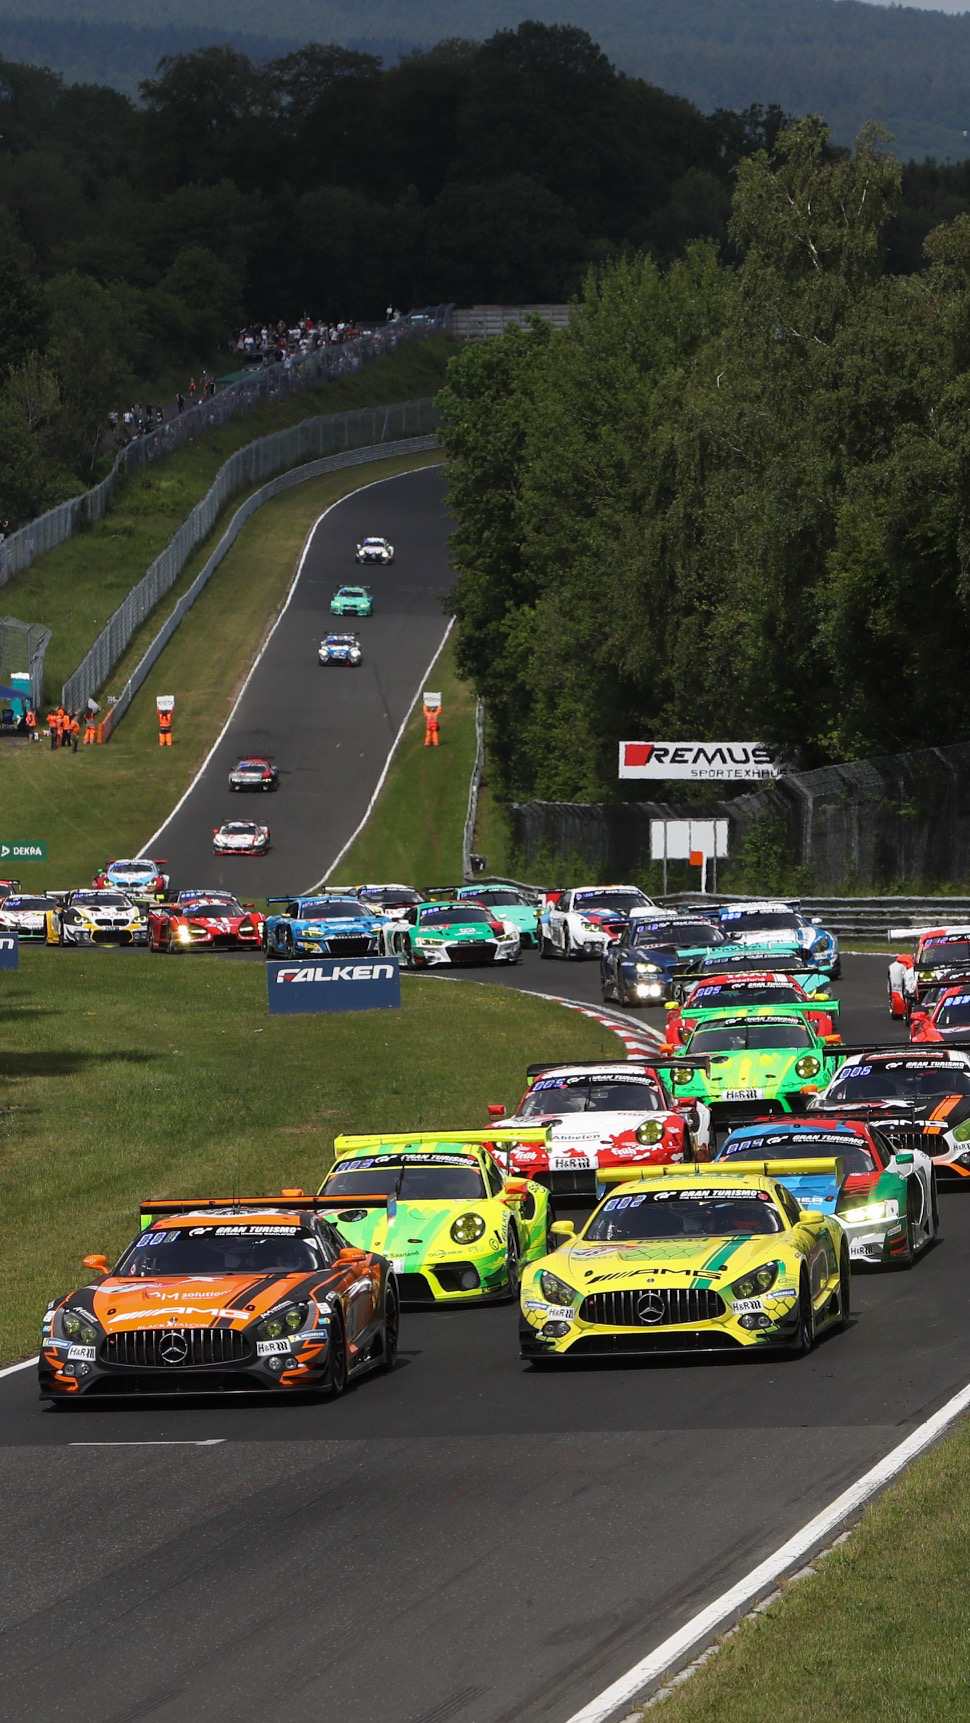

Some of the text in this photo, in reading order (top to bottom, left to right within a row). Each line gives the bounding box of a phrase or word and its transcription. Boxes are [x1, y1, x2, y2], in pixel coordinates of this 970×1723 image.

[647, 747, 776, 766] REMUS
[13, 847, 42, 856] DEKRA
[277, 963, 395, 984] FALKEN
[821, 1134, 866, 1144] TURISMO
[555, 1159, 577, 1168] H&R
[603, 1194, 647, 1211] 002
[69, 1347, 87, 1356] H&R
[258, 1343, 276, 1353] H&R
